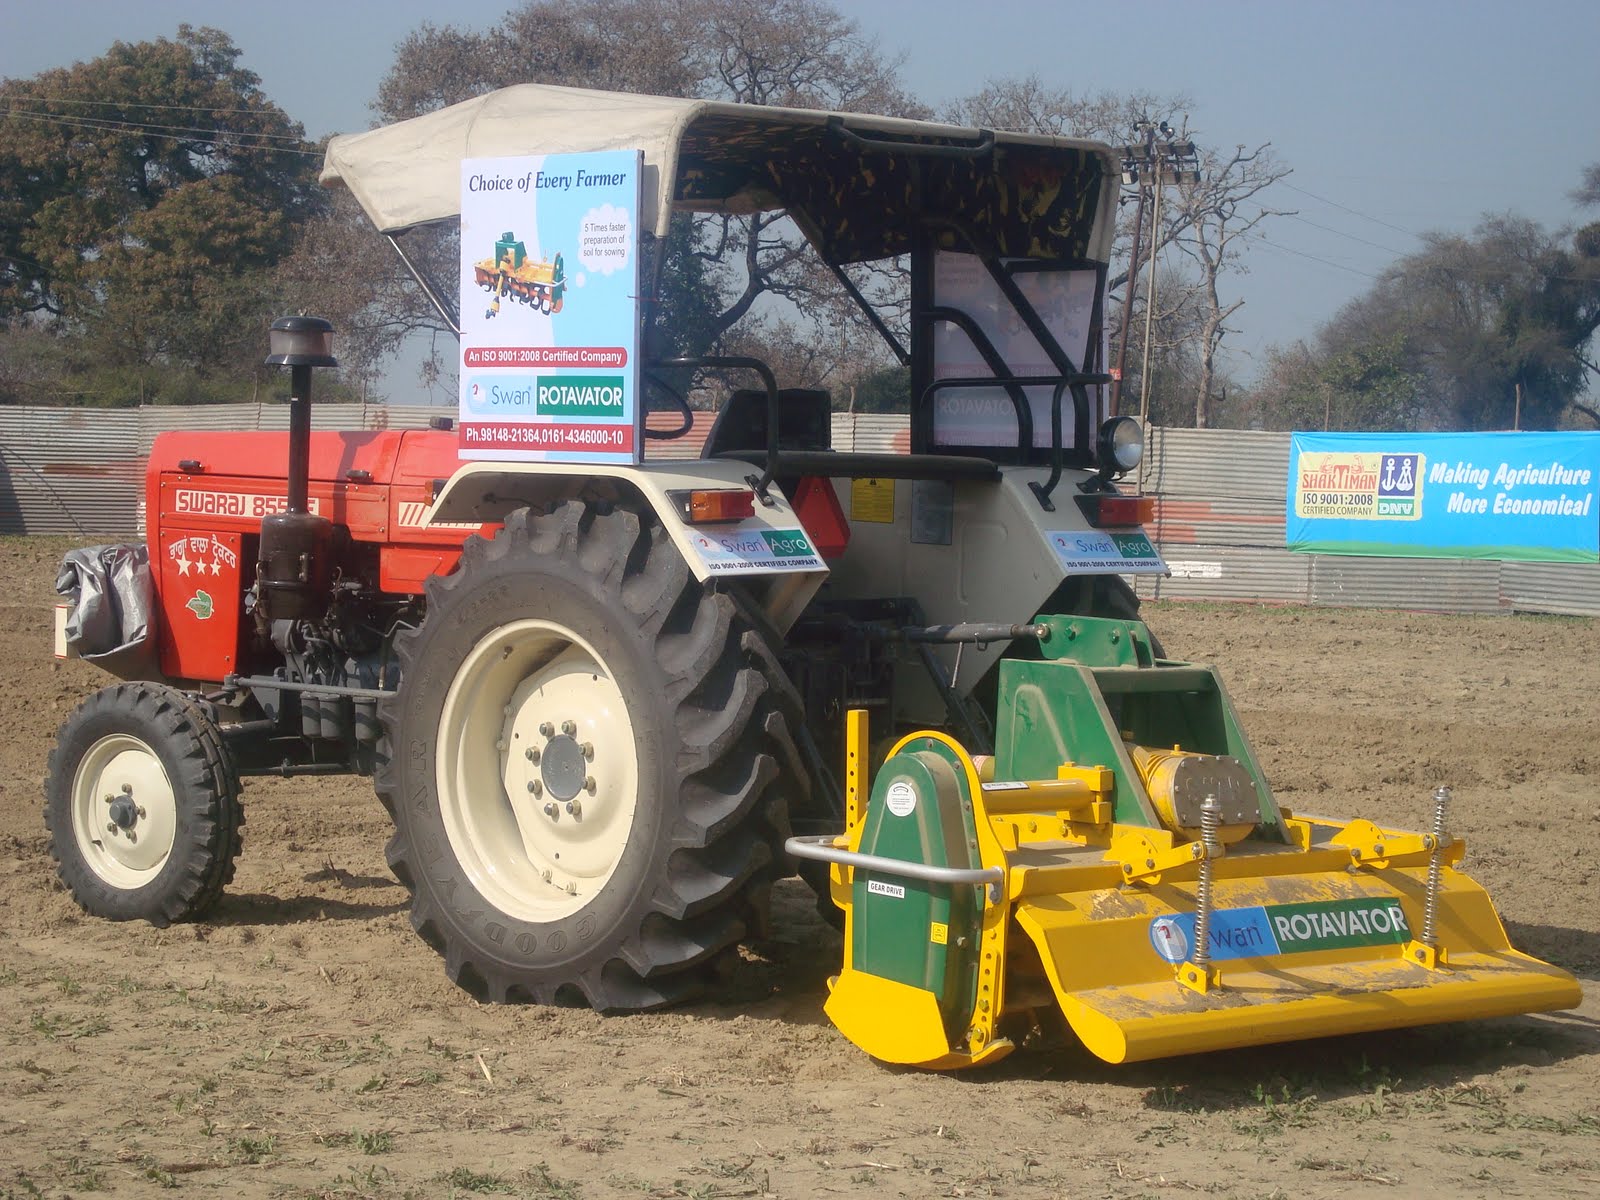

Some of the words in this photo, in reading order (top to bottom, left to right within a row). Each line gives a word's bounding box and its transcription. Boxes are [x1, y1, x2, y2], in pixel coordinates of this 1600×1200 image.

[469, 175, 513, 192] Choice
[517, 172, 532, 193] of
[535, 171, 572, 191] Every
[576, 170, 626, 187] Farmer
[584, 223, 589, 232] 5
[590, 223, 608, 232] Times
[609, 222, 626, 231] faster
[584, 236, 617, 246] preparation
[618, 235, 625, 244] of
[583, 247, 593, 256] soil
[594, 247, 603, 256] for
[604, 248, 625, 258] sowing
[469, 351, 480, 361] An
[482, 351, 497, 361] ISO
[498, 351, 540, 361] 9001:2008
[542, 350, 579, 362] Certified
[580, 351, 622, 364] Company
[492, 385, 530, 405] Swan
[539, 386, 622, 406] ROTAVATOR
[1302, 464, 1377, 490] SHAKTIMAN
[1429, 462, 1490, 491] Making
[1493, 462, 1591, 491] Agriculture
[1303, 493, 1318, 505] ISO
[1320, 494, 1374, 506] 9001:2008
[1447, 493, 1487, 514] More
[1493, 493, 1592, 517] Economical
[1302, 505, 1336, 516] CERTIFIED
[1336, 506, 1373, 516] COMPANY
[1379, 502, 1413, 515] DNV
[190, 537, 209, 553] ਵਾਲਾ
[721, 539, 765, 553] Swan
[770, 538, 808, 553] Agro
[1076, 540, 1115, 553] Swan
[1119, 540, 1150, 555] Agro
[755, 560, 787, 568] CERTIFIED
[870, 882, 886, 892] GEAR
[886, 885, 903, 896] DRIVE
[1193, 924, 1264, 950] wan
[1273, 905, 1409, 941] ROTAVATOR
